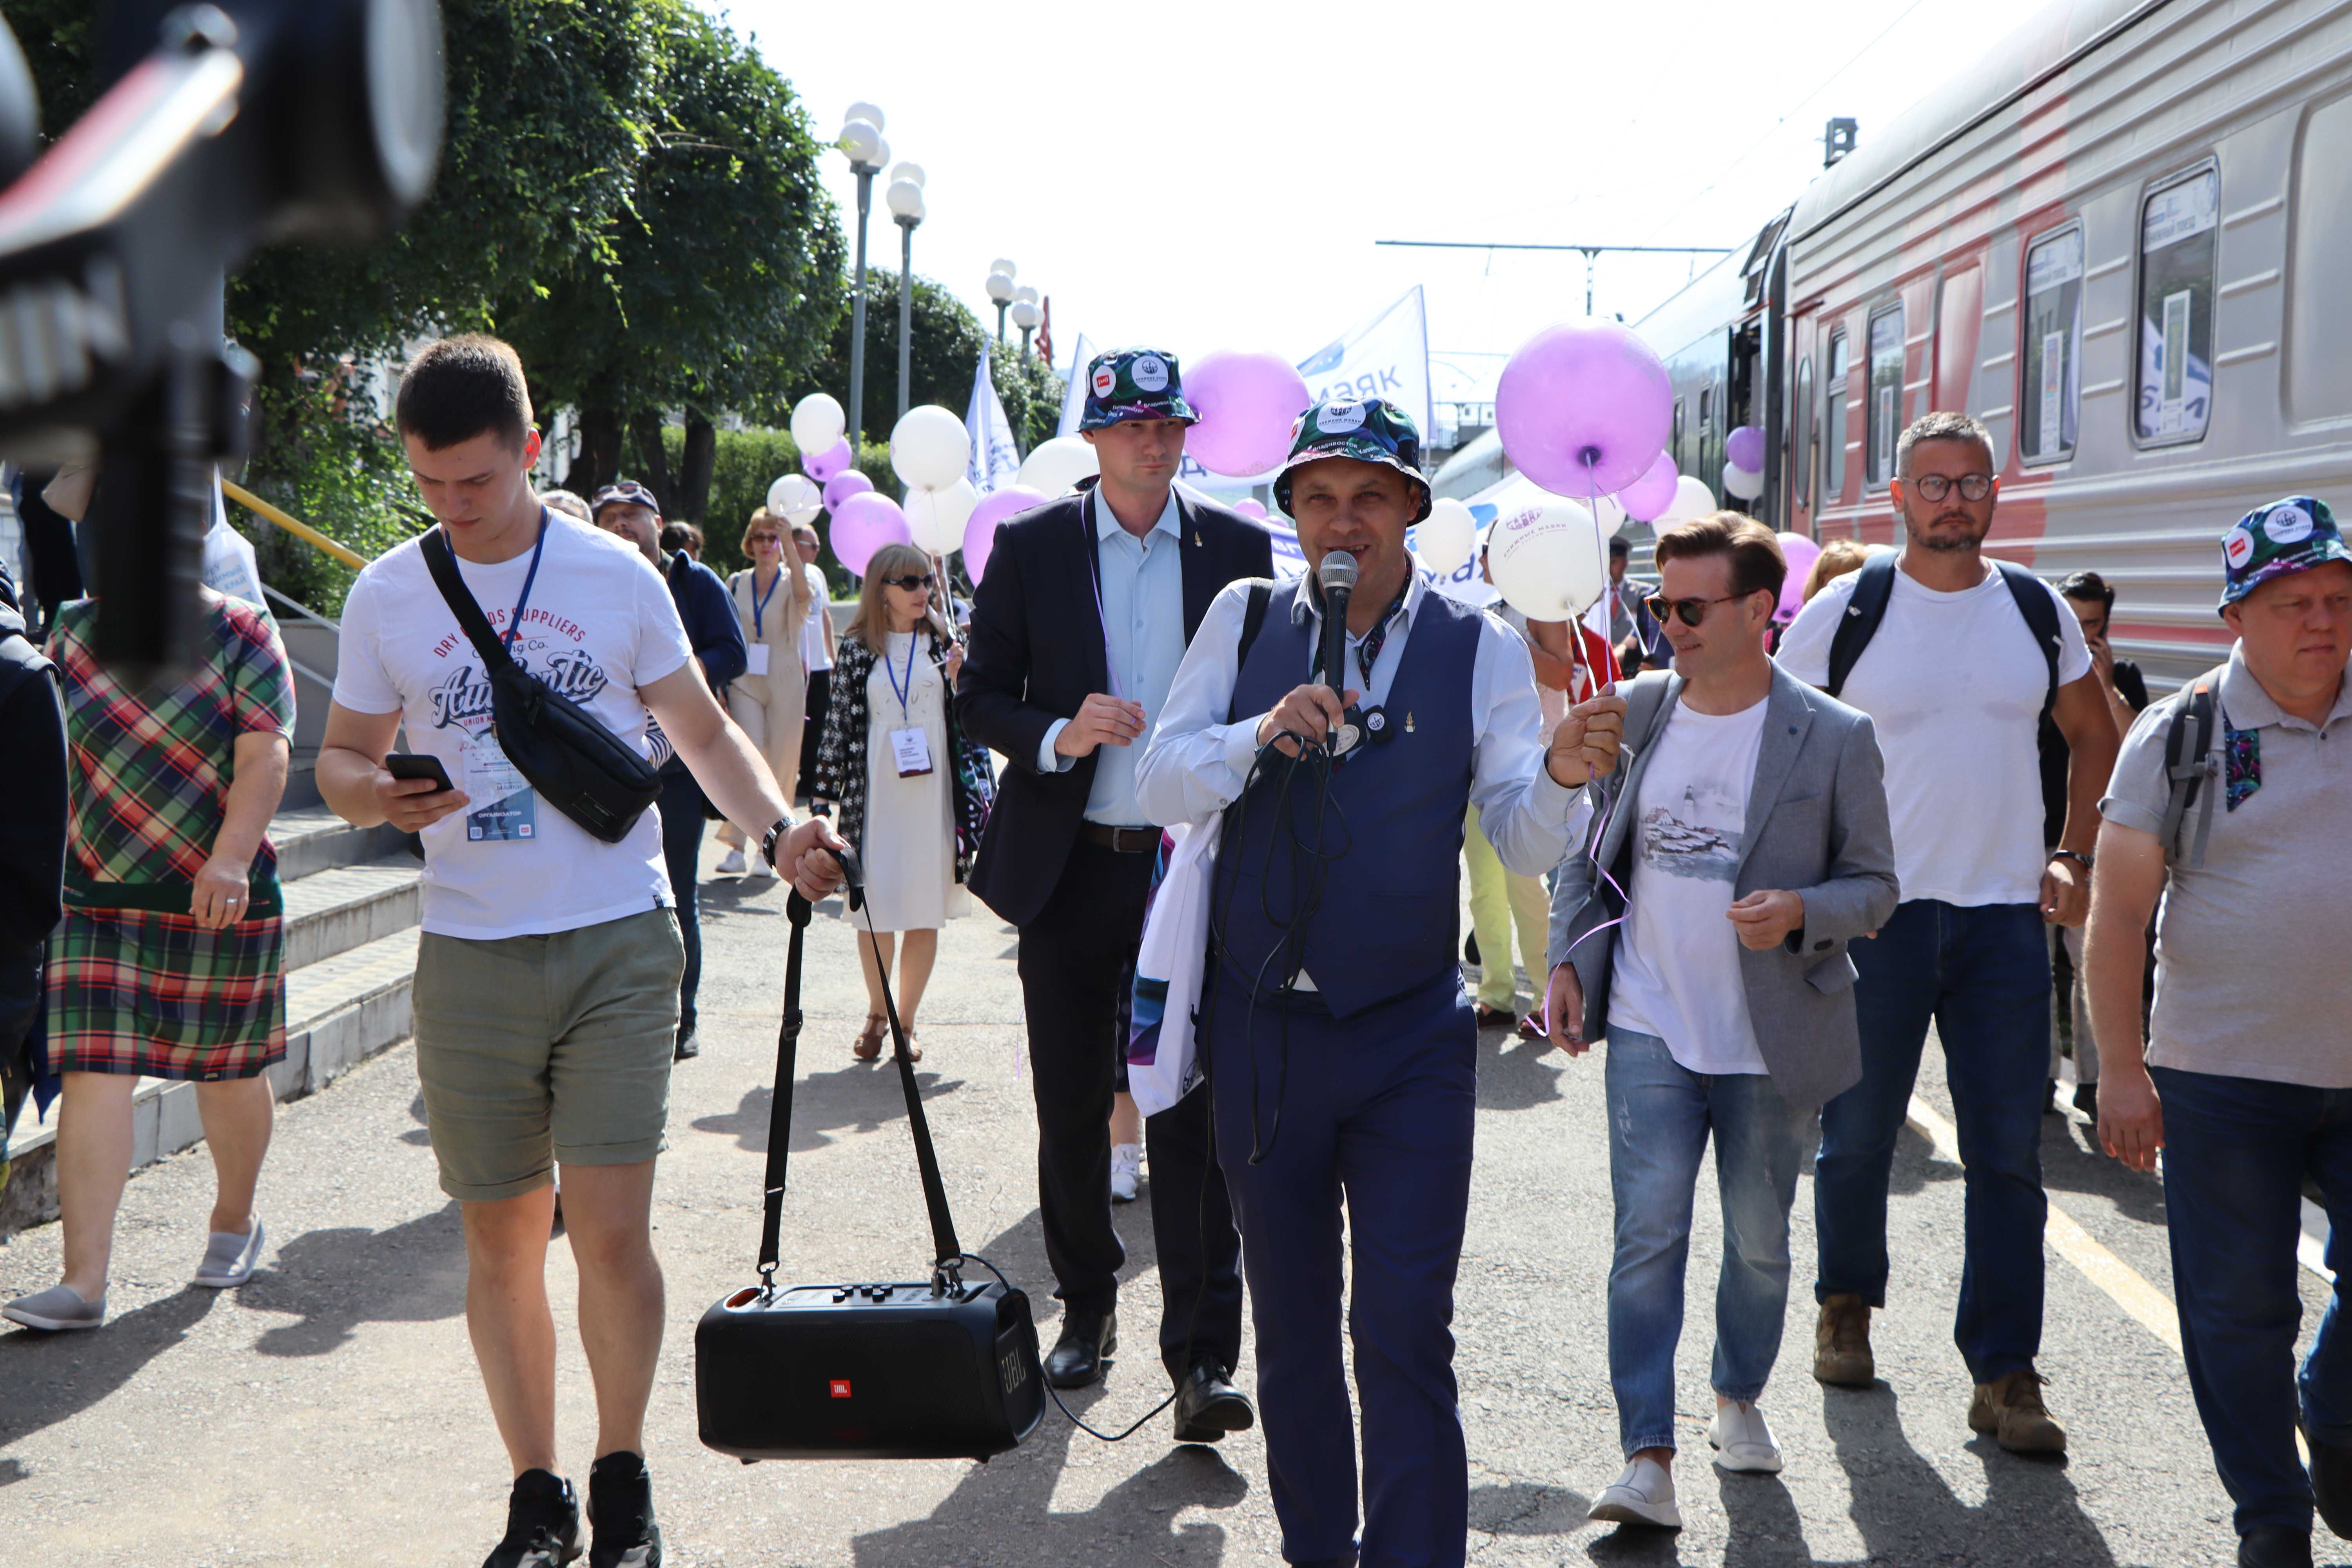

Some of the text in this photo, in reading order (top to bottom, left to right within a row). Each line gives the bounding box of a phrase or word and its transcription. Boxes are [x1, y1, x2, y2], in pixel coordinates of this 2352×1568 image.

[1311, 364, 1403, 405] аяк
[1503, 529, 1536, 558] КНИЖНЫЕ
[433, 633, 459, 658] DRY
[528, 640, 548, 651] Co.
[463, 716, 484, 727] UNION
[1001, 1347, 1026, 1394] JBL
[834, 1384, 848, 1394] JBL
